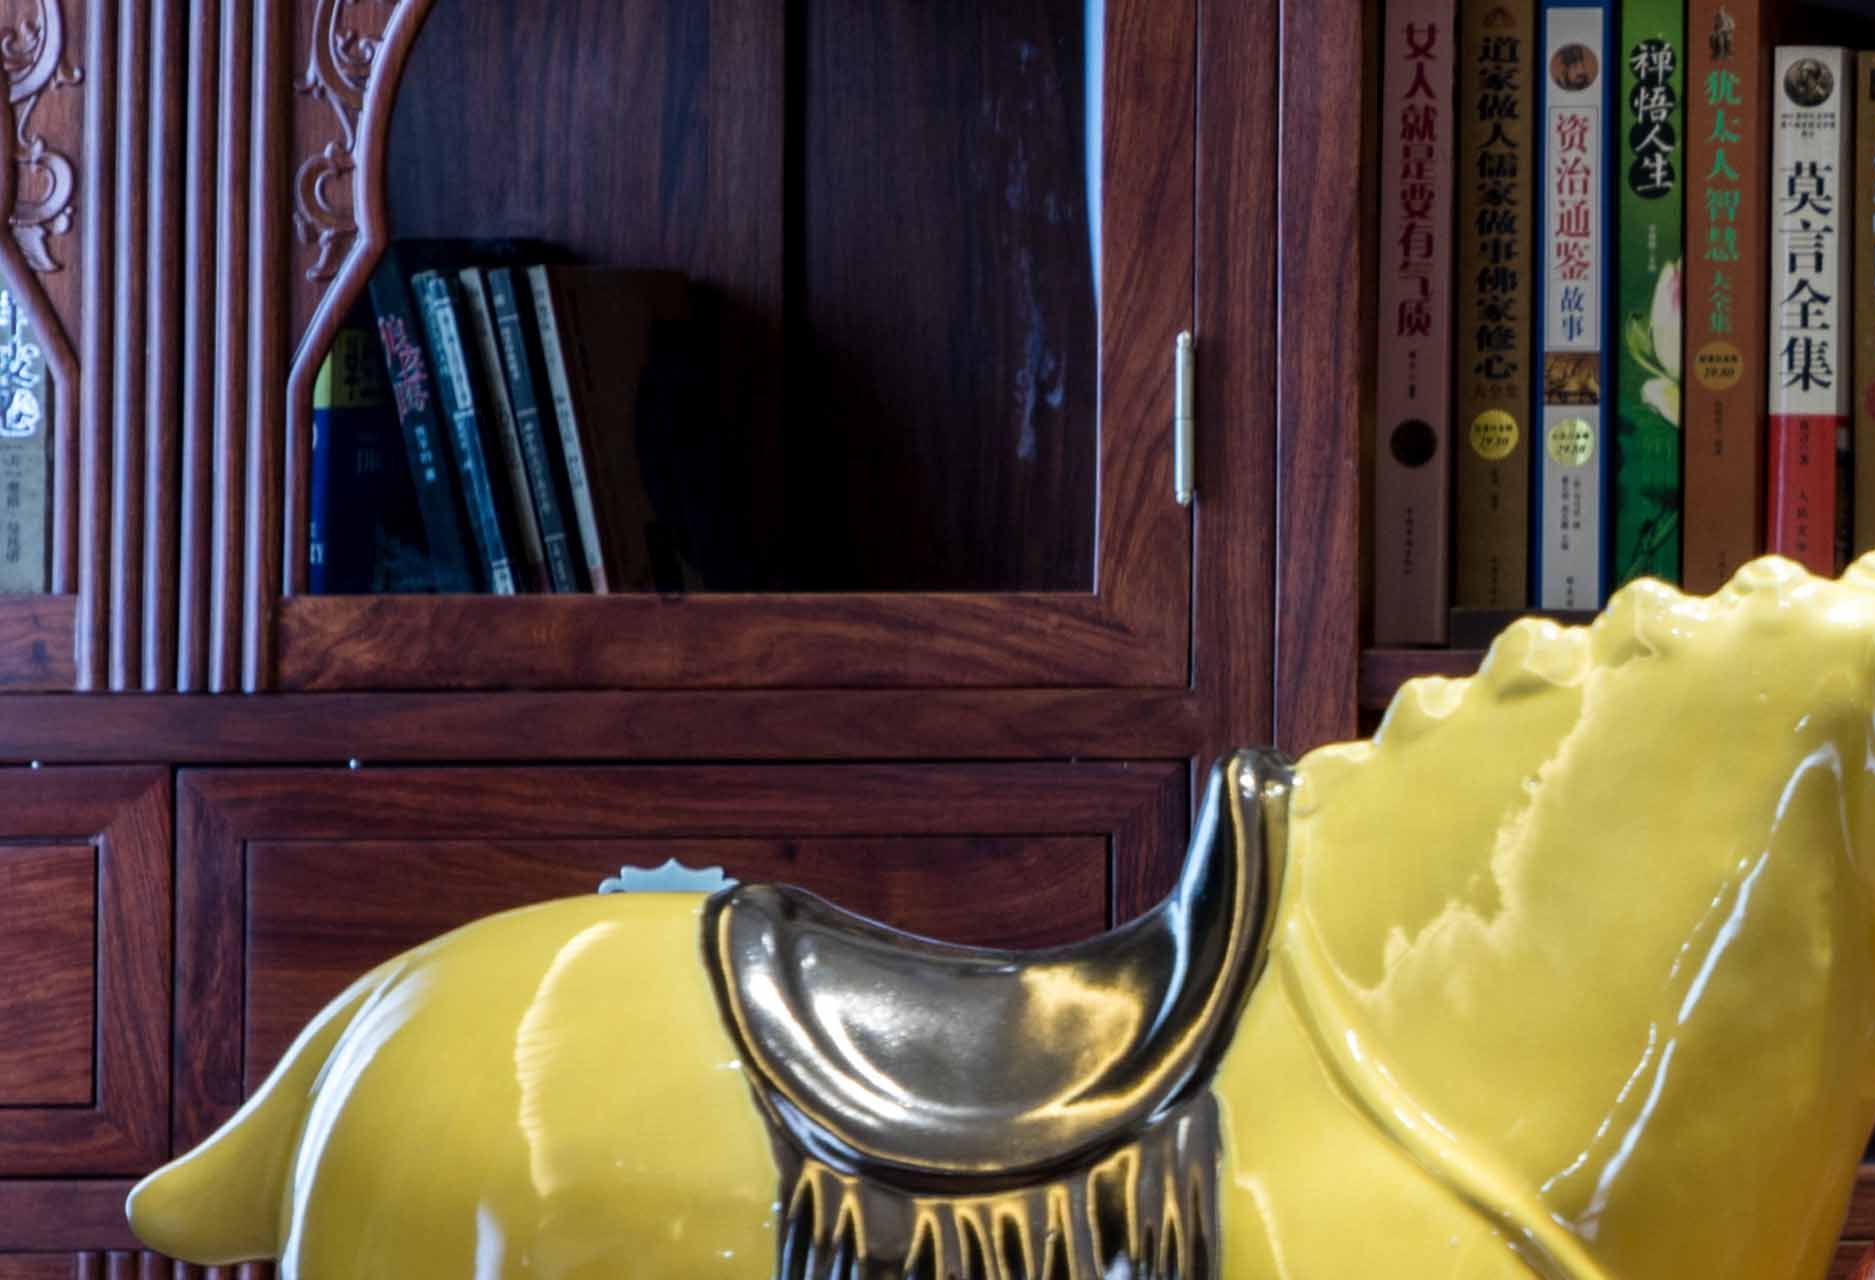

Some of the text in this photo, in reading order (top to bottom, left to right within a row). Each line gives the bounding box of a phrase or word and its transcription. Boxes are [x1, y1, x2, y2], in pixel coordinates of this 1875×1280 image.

[1396, 22, 1438, 337] 女人就是要有气质
[1473, 37, 1521, 379] 道家做人儒家做事佛家修心
[1554, 113, 1592, 341] 资治通鉴 故事
[1629, 42, 1675, 193] 禅悟人生
[1702, 69, 1743, 262] 犹太人智慧
[1710, 272, 1731, 336] 大全集
[1778, 161, 1835, 392] 莫言全集
